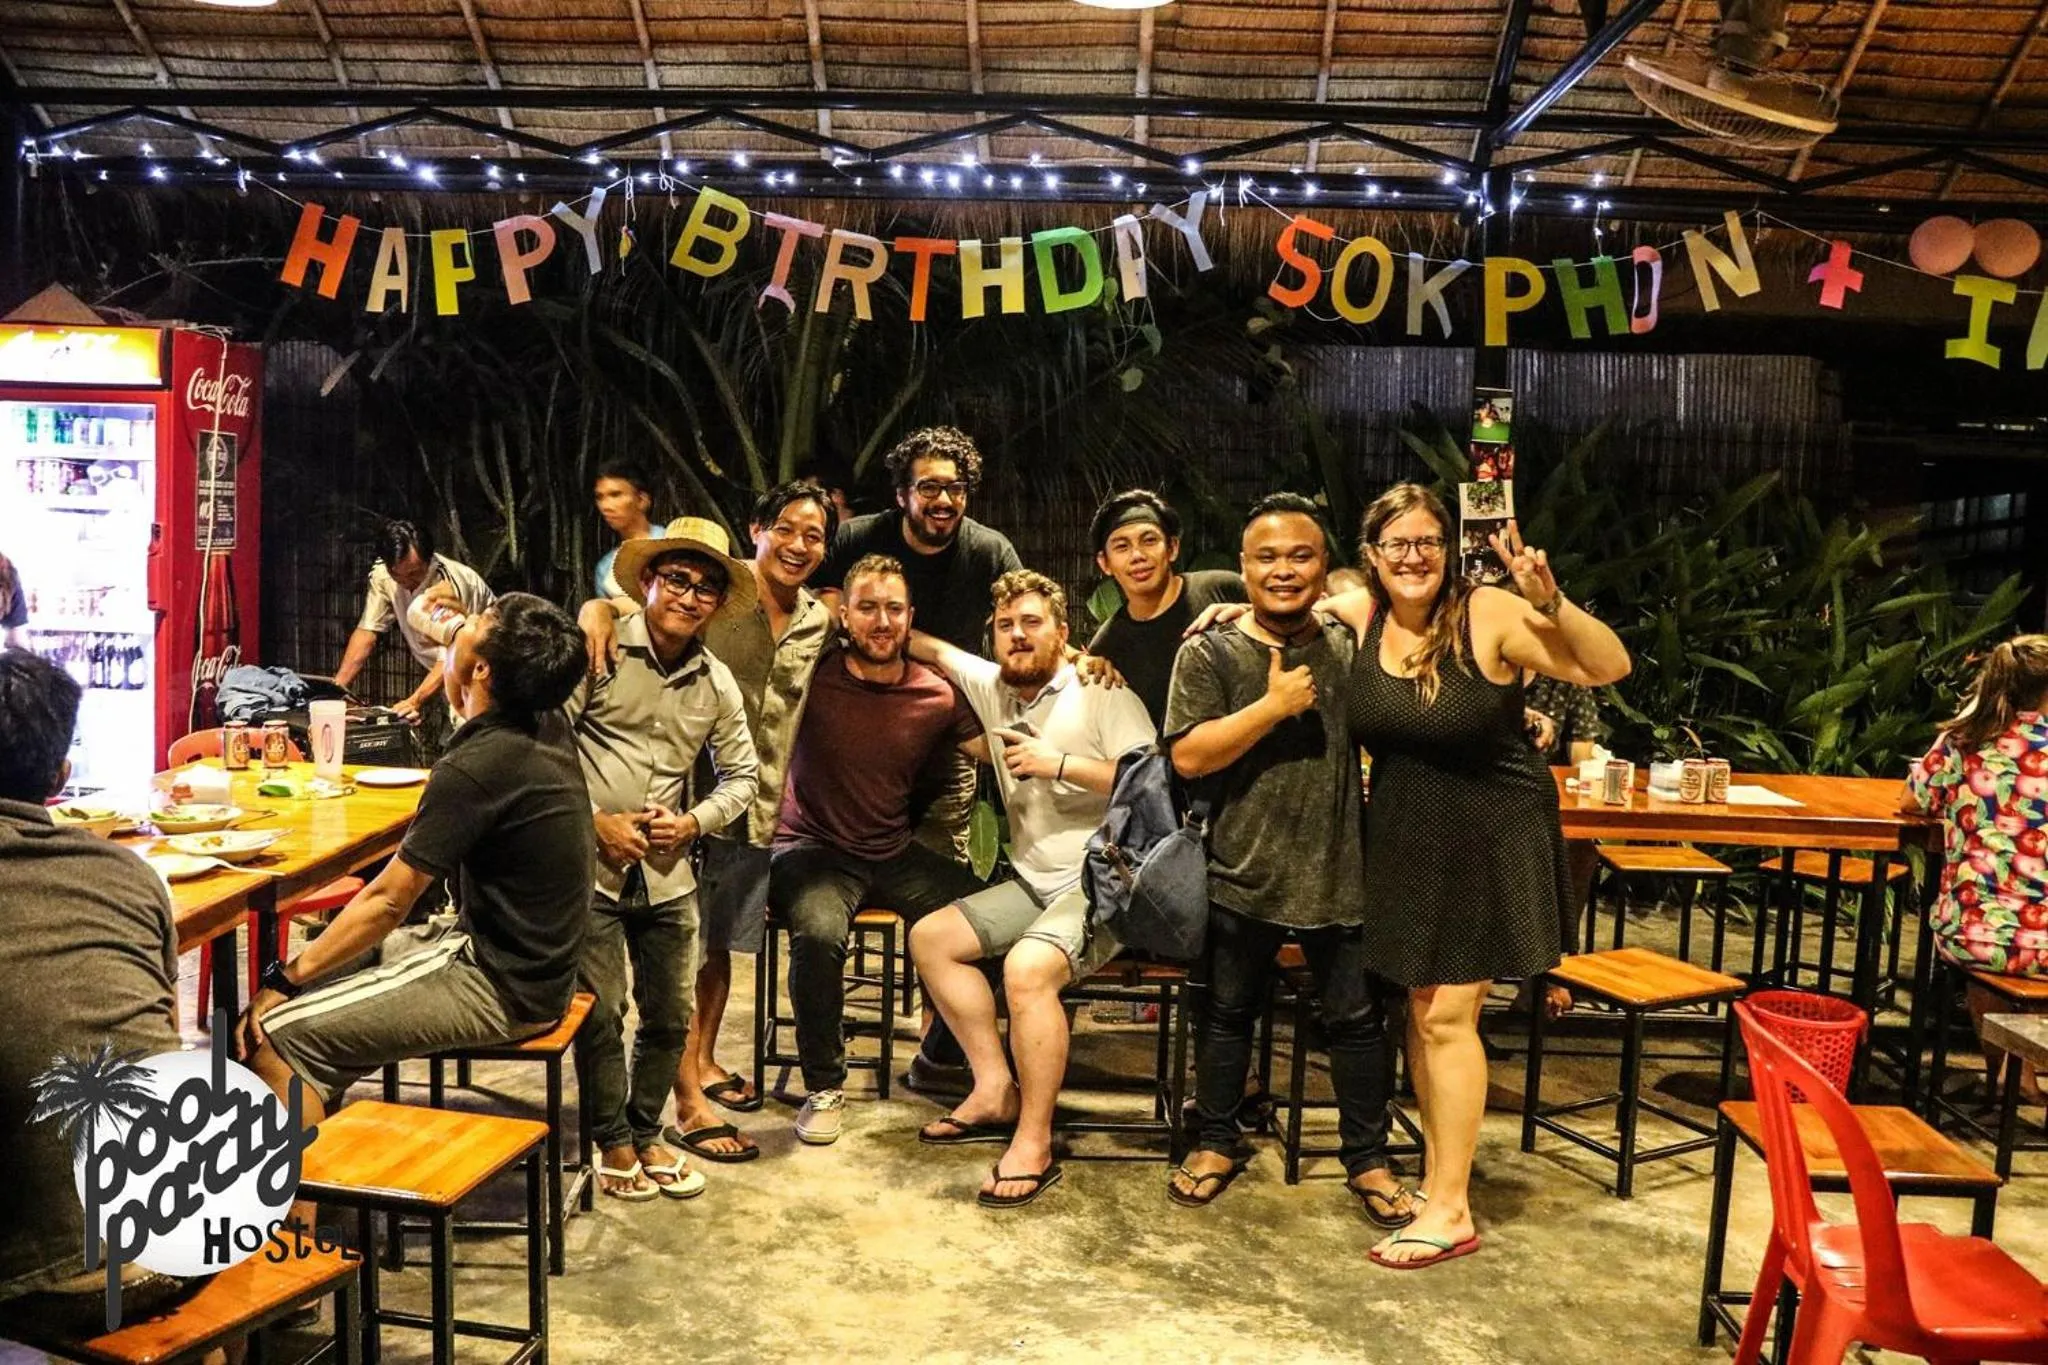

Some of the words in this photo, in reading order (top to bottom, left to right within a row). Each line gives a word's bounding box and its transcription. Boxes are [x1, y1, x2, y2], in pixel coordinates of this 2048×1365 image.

[279, 187, 606, 315] HAPPY
[670, 186, 1213, 322] BIRTHDAY
[1268, 210, 1761, 346] SOKPHON
